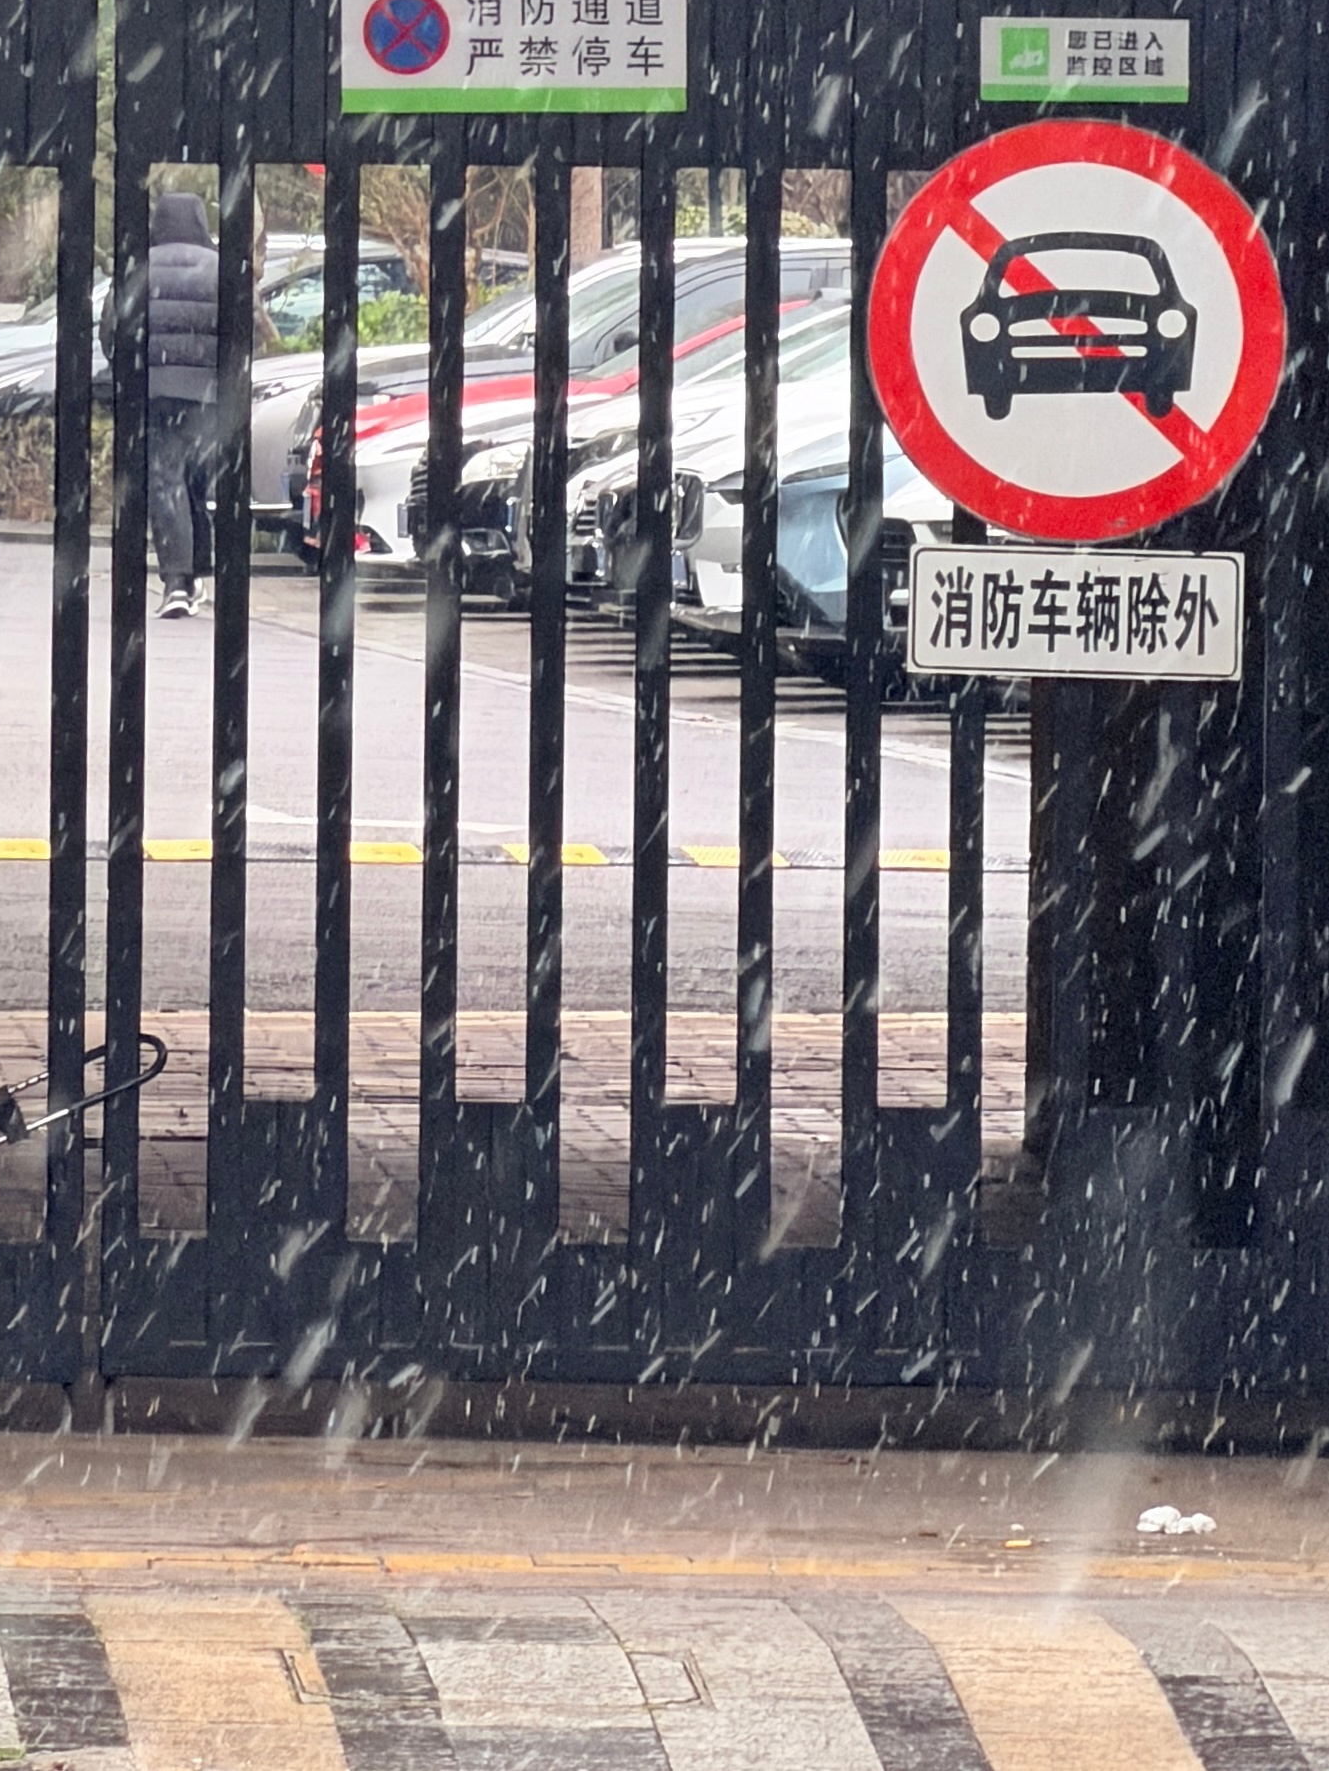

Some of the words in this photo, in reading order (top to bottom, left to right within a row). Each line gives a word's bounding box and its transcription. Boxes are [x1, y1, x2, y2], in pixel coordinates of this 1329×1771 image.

[466, 35, 665, 77] 严禁停车
[1067, 30, 1164, 51] 您已进入
[1066, 54, 1164, 76] 监控区域
[929, 566, 1220, 656] 消防车辆除外
